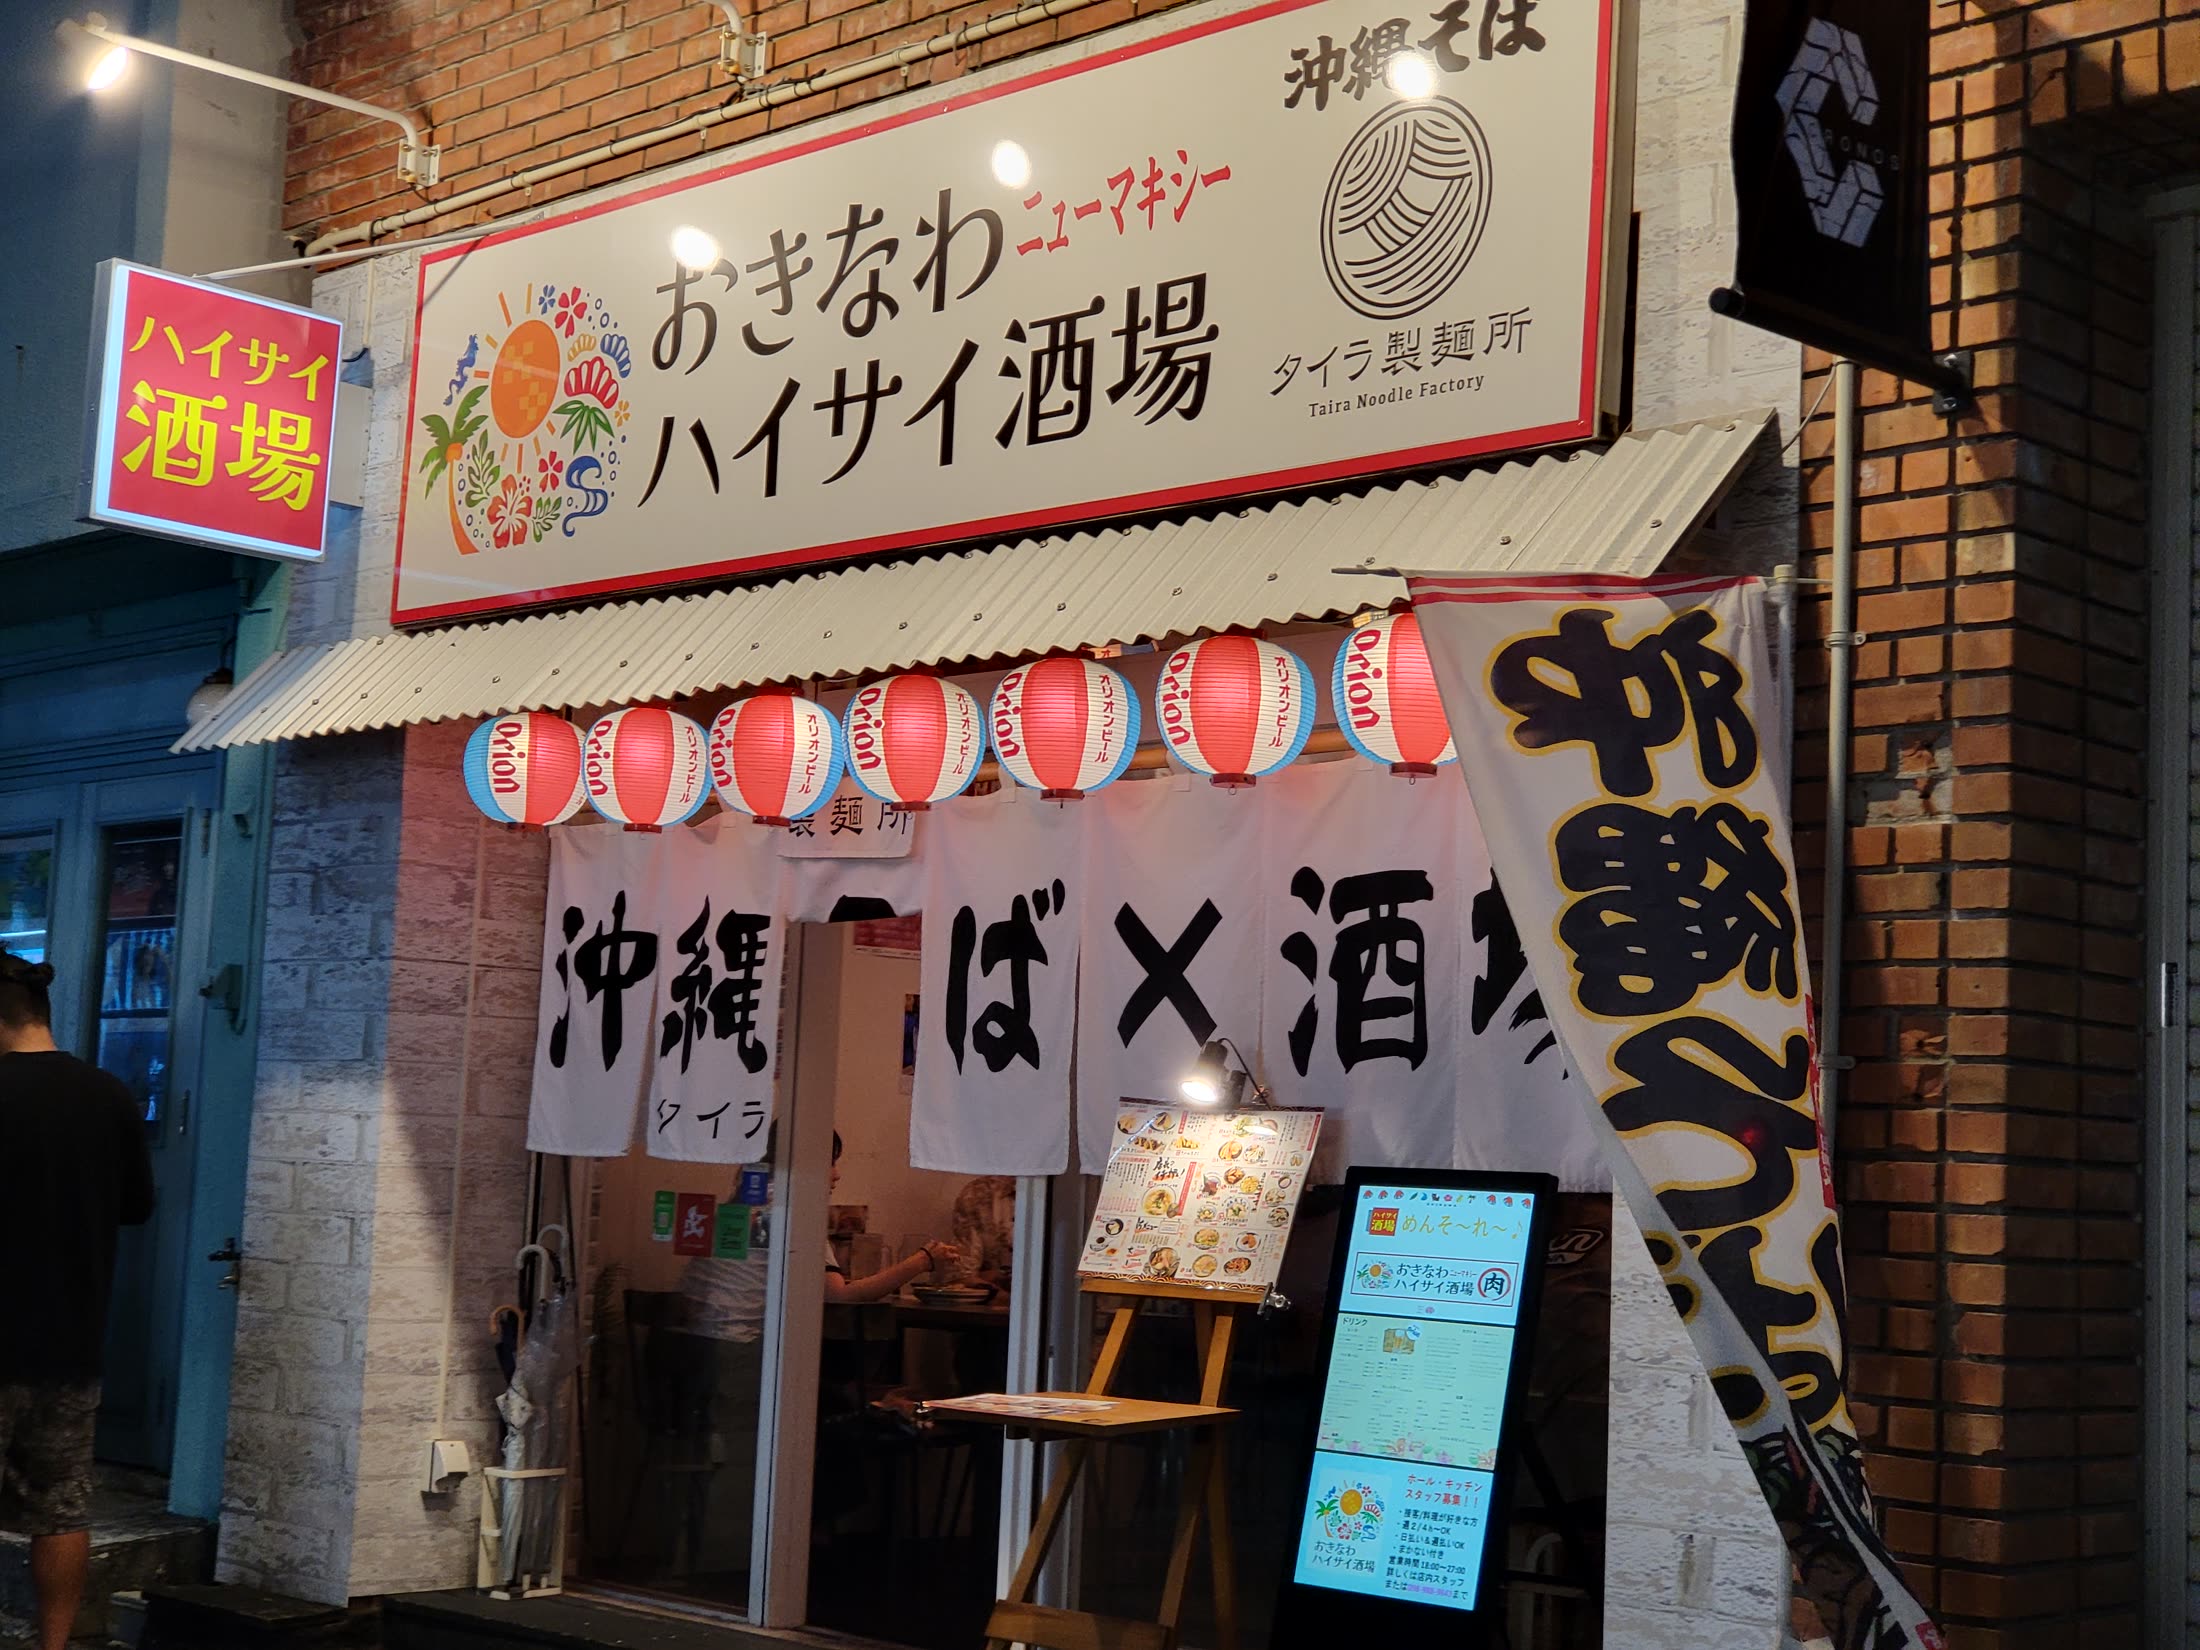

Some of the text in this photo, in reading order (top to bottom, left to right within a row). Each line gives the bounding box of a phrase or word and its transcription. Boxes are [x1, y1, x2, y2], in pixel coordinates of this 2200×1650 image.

[651, 148, 1232, 376] おきなわ ニューマキシー
[128, 315, 331, 403] ハイサイ
[637, 272, 1220, 508] ハイサイ酒場
[1270, 306, 1534, 397] タイラ製麺所
[1308, 374, 1485, 418] Taira Noodle Factory
[121, 379, 322, 513] 酒場
[995, 671, 1022, 759] Orion
[1094, 673, 1115, 763] オリオンビール
[1161, 651, 1191, 747] Orion
[1268, 655, 1290, 748] オリオンビール
[1345, 629, 1381, 730] Orion
[491, 722, 523, 794] Orion
[582, 719, 613, 797] Orion
[679, 724, 702, 805] オリオンビール
[709, 707, 736, 788] Orion
[797, 713, 819, 795] オリオンビール
[853, 687, 884, 771] Orion
[952, 690, 973, 776] オリオンビール
[656, 1098, 768, 1141] タイラ
[1371, 1219, 1396, 1232] 酒場
[1373, 1211, 1397, 1219] ハイサイ
[1393, 1278, 1475, 1297] ハイサイ酒場
[1396, 1263, 1449, 1279] おきなわ
[1483, 1272, 1505, 1296] 肉
[1407, 1474, 1483, 1493] ホール・キッチン
[1312, 1554, 1376, 1574] ハイサイ酒場
[1314, 1541, 1356, 1556] おきなわ
